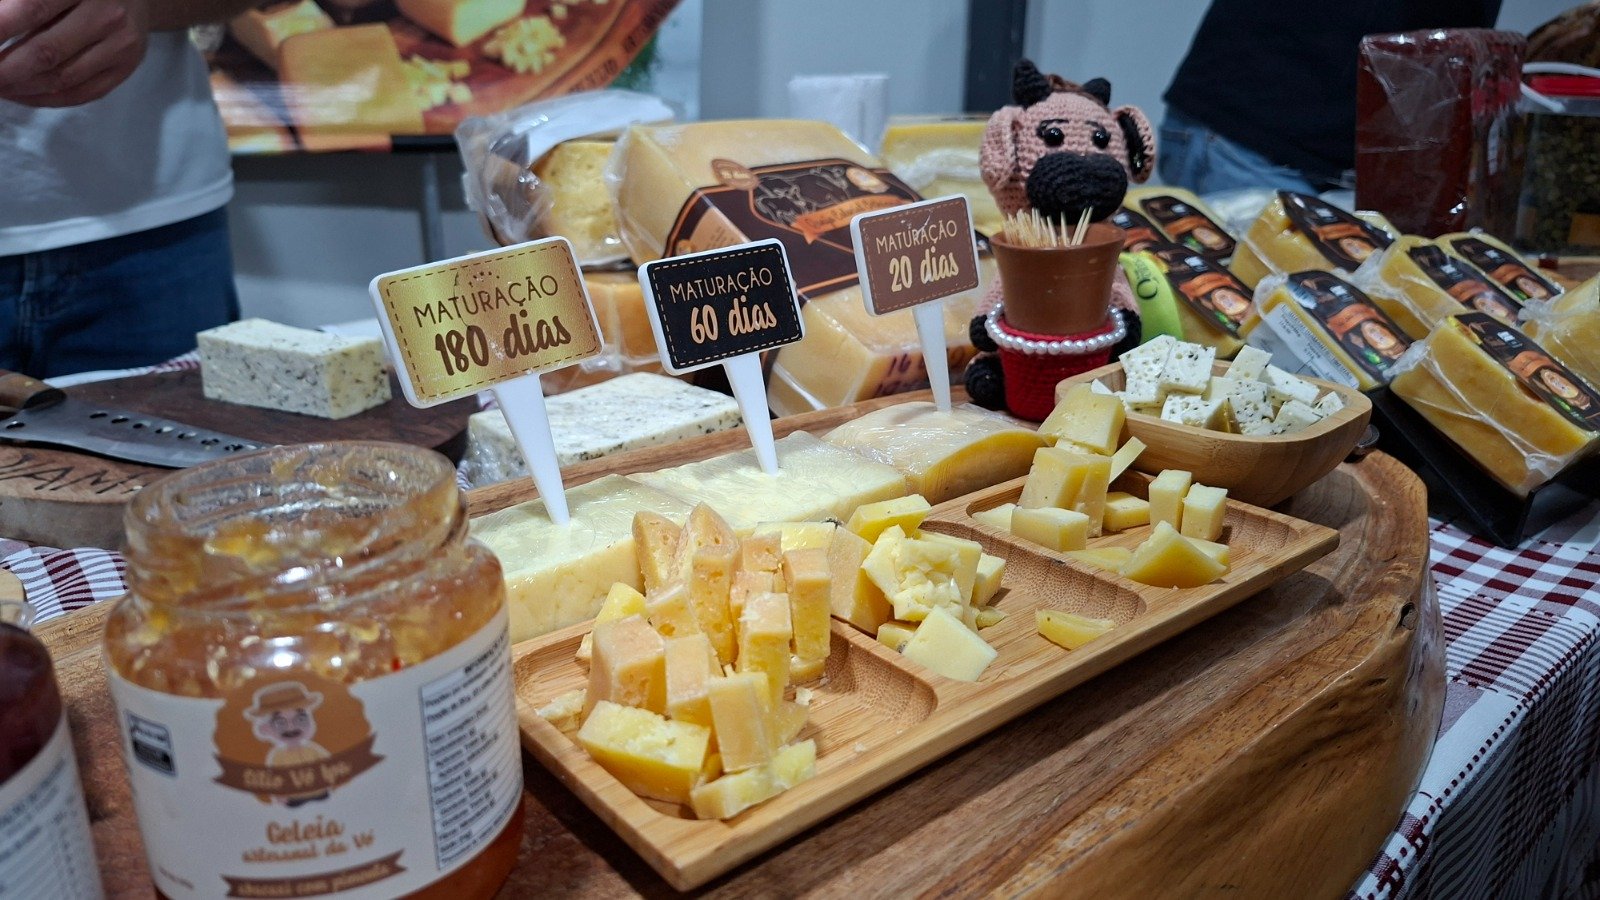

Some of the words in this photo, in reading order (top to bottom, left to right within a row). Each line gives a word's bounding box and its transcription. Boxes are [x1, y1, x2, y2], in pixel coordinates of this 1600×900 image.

[875, 219, 958, 255] MATURAÇÃO
[669, 267, 773, 304] MATURAÇÃO
[888, 255, 913, 293] 20
[920, 245, 959, 285] dias
[412, 274, 559, 328] MATURAÇÃO
[690, 304, 719, 344] 60
[728, 294, 778, 336] dias
[434, 324, 490, 376] 180
[502, 309, 572, 359] dias
